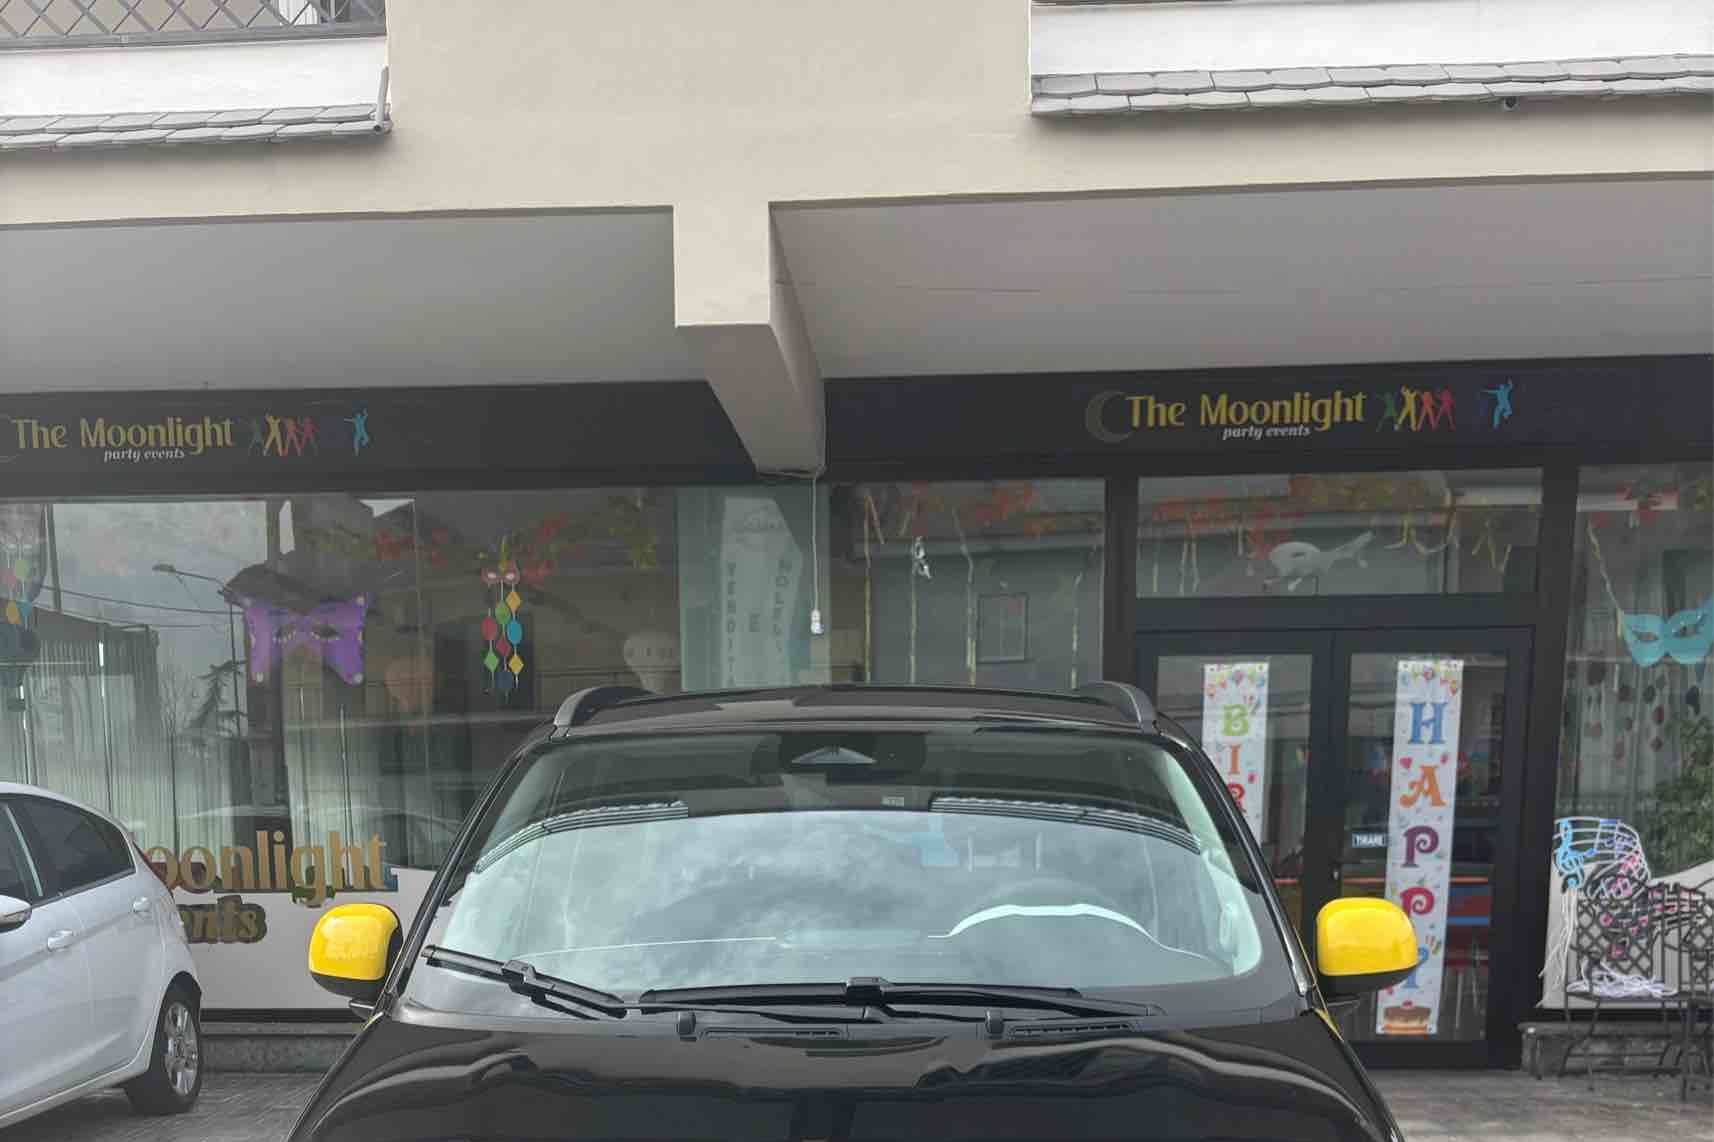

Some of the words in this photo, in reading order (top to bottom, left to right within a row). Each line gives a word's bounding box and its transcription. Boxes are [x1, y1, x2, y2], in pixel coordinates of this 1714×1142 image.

[1125, 394, 1186, 428] The
[1200, 389, 1367, 432] Moonlight
[11, 417, 68, 449] The
[79, 415, 235, 455] Moonlight
[1222, 424, 1263, 441] party
[1265, 423, 1311, 438] events
[103, 448, 141, 463] party
[143, 446, 185, 460] events
[146, 830, 385, 908] oonlight
